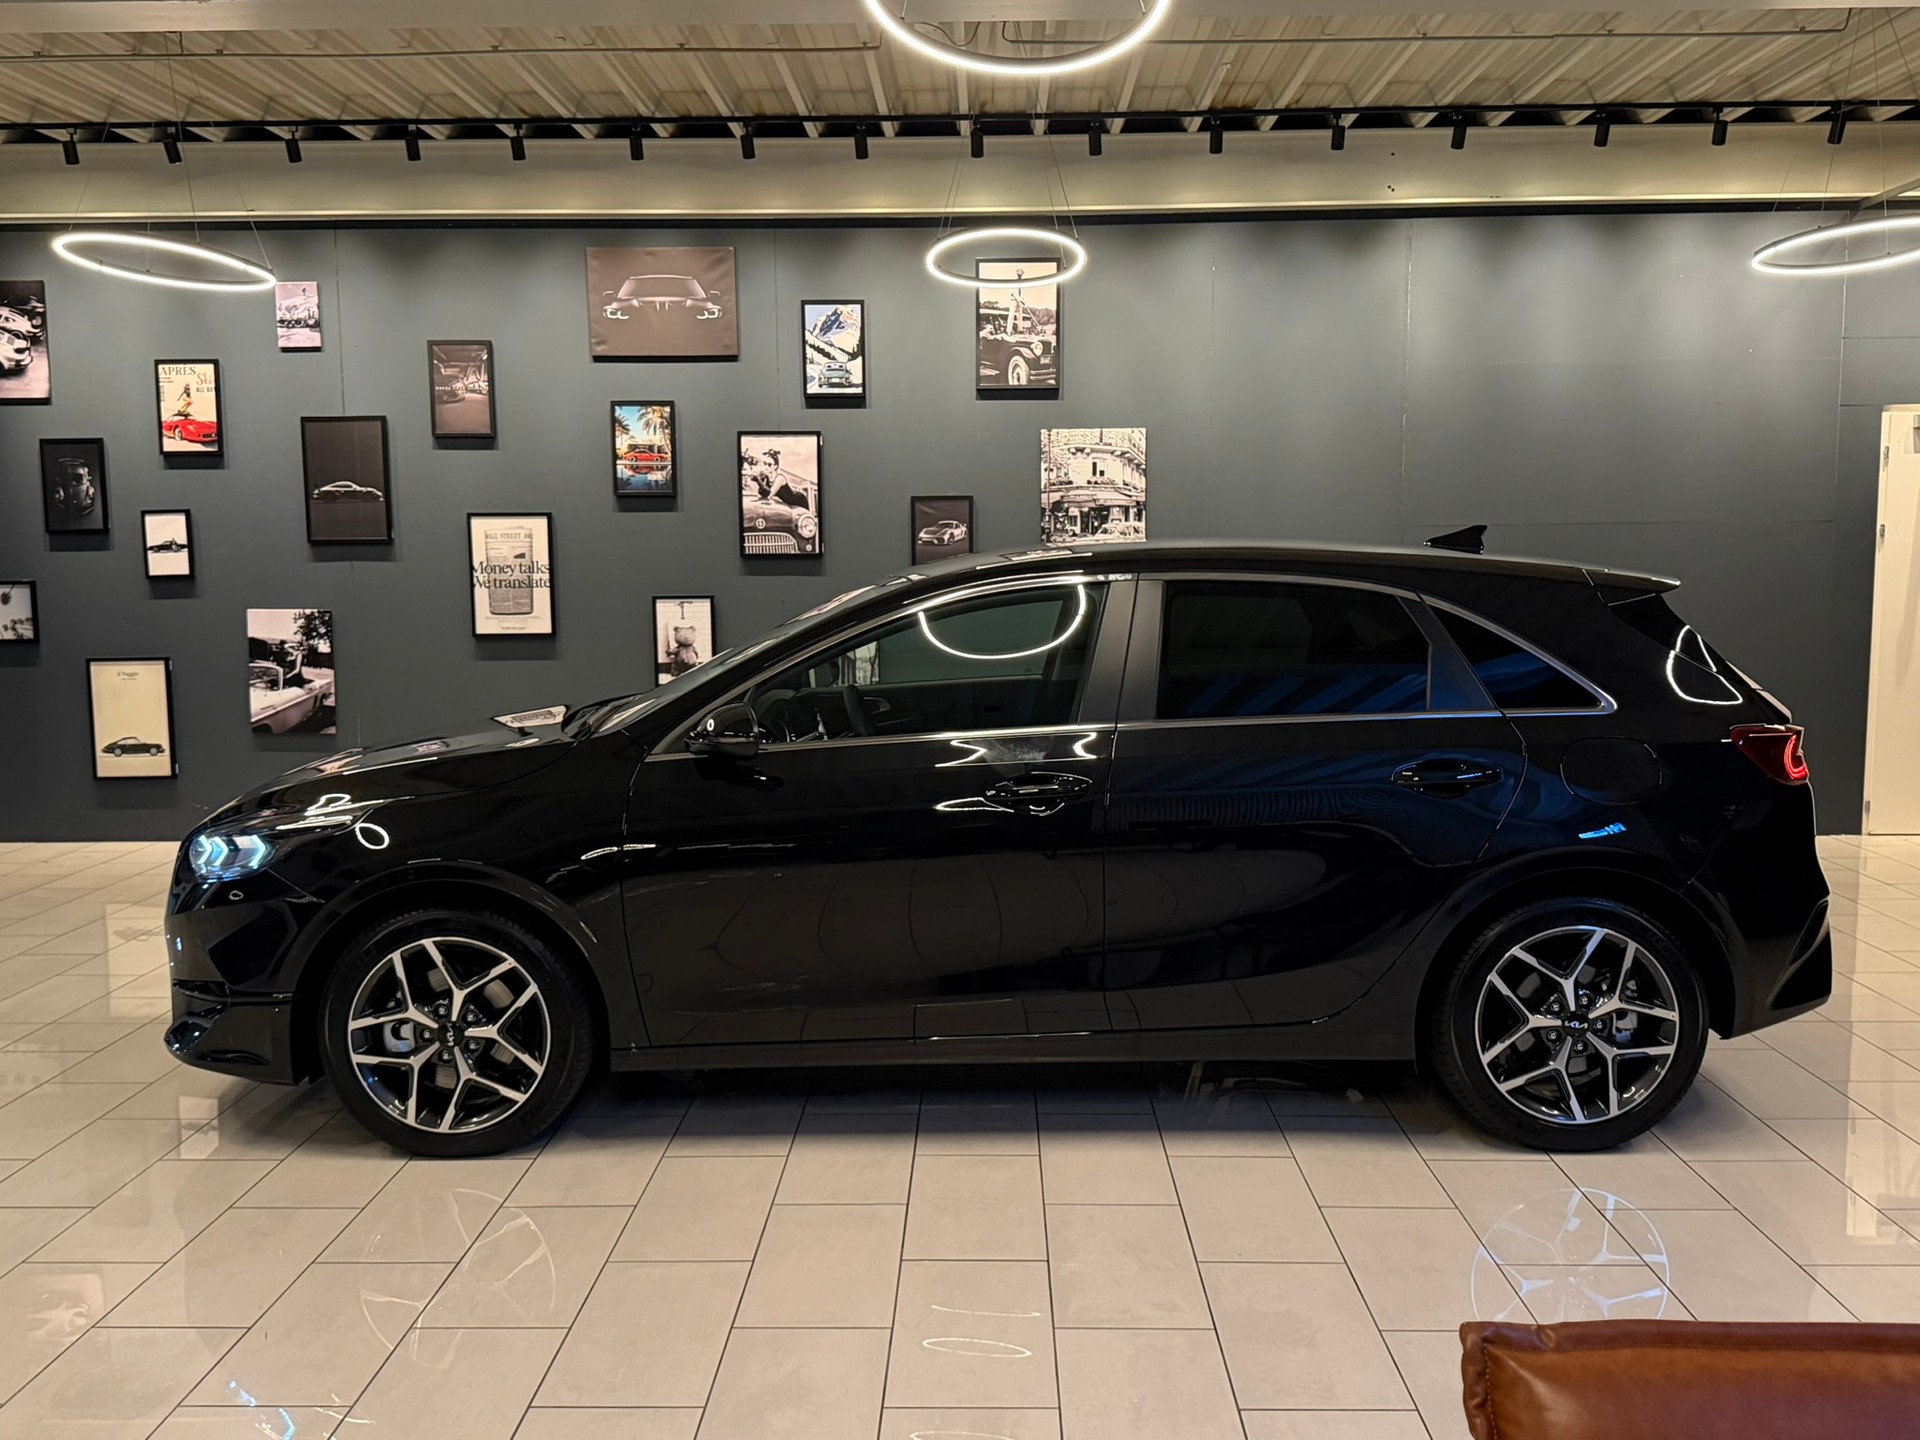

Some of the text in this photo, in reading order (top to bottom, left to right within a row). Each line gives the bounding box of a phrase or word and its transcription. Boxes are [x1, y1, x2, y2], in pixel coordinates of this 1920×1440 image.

[196, 372, 213, 386] Ski
[473, 560, 550, 577] Money talks
[474, 575, 551, 590] We translate
